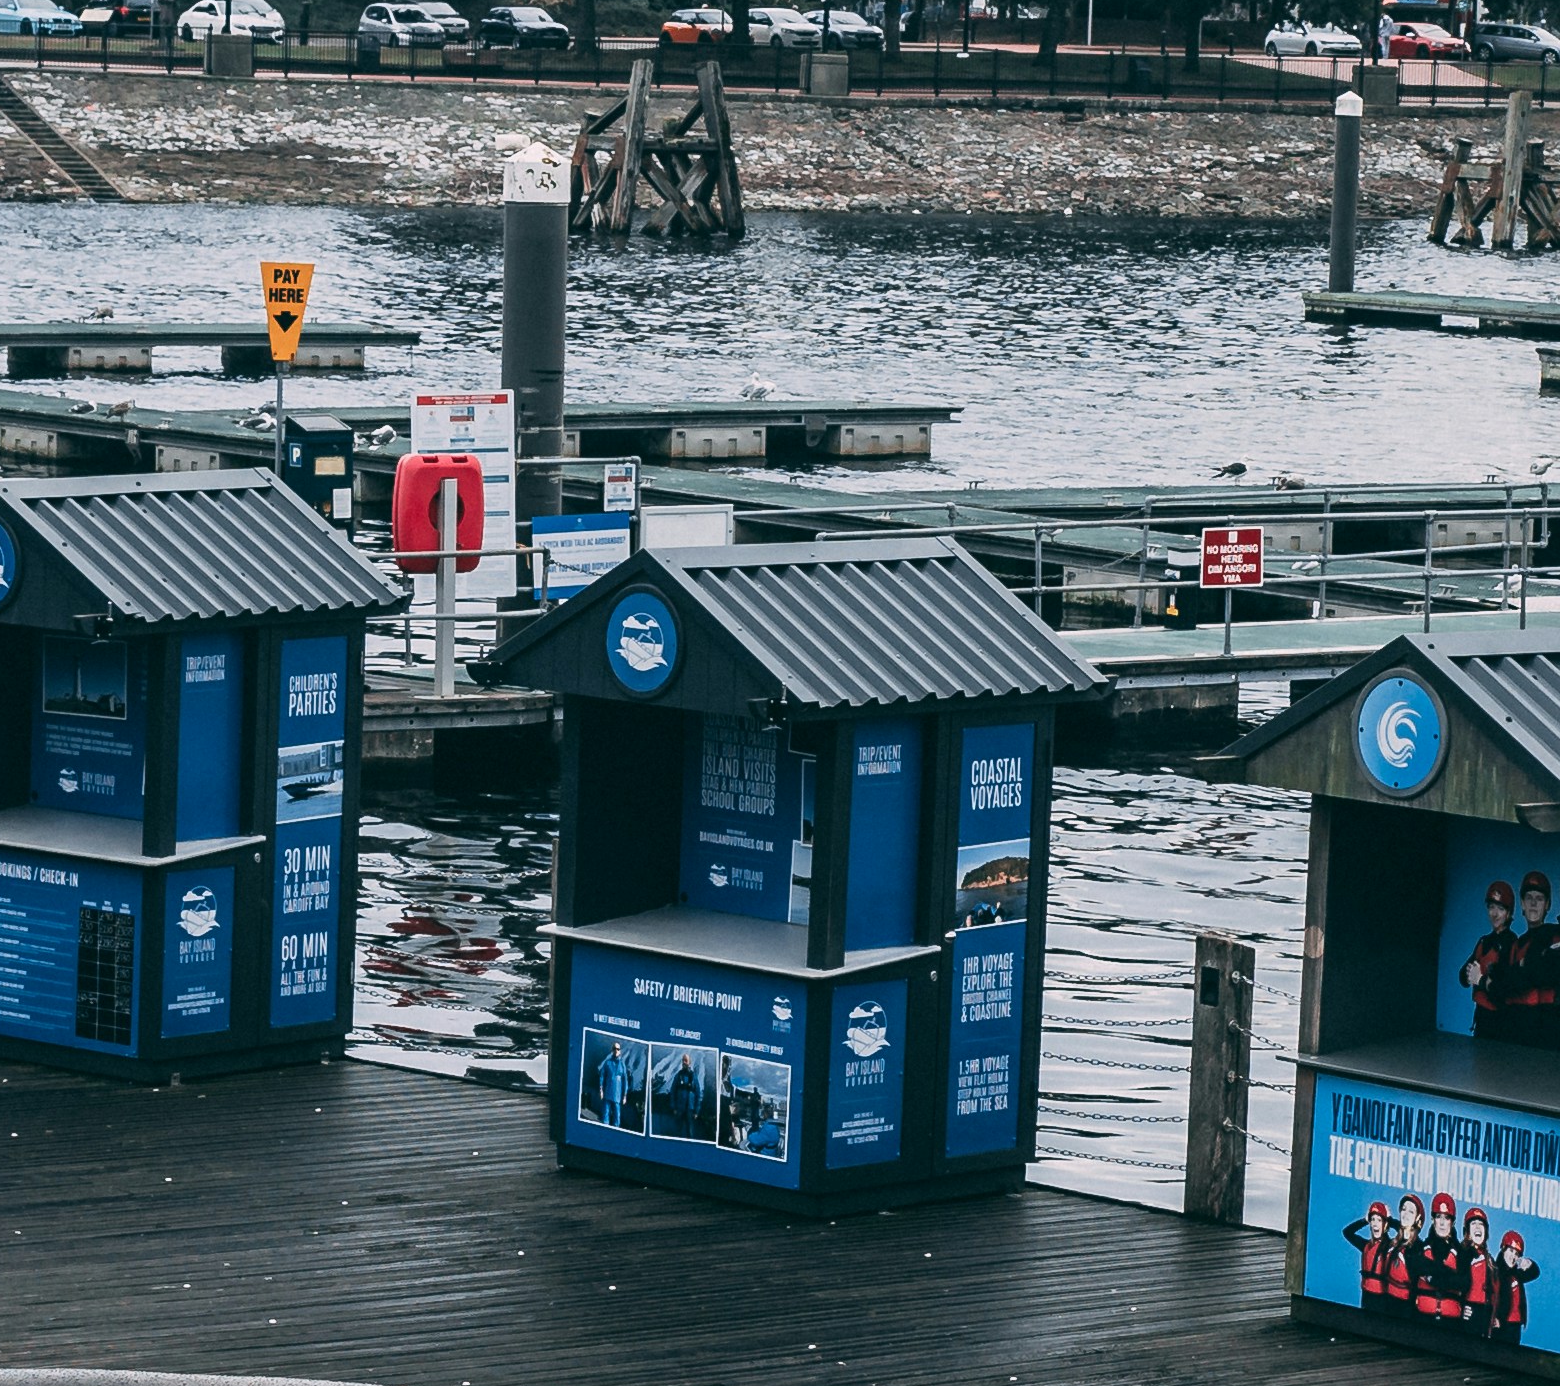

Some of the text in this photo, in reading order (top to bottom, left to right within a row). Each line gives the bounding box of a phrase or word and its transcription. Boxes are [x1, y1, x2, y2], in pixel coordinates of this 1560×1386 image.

[273, 268, 300, 284] PAY
[268, 287, 304, 303] HERE
[1206, 544, 1219, 554] NO
[289, 672, 338, 693] CHILDREN'S
[288, 689, 337, 718] PARTIES
[971, 757, 1023, 786] COASTAL
[701, 788, 775, 816] SCHOOL GROUPS
[970, 782, 1022, 811] VOYAGES
[284, 844, 331, 875] 30 MIN
[40, 867, 79, 888] CHECK-IN
[281, 931, 328, 961] 60 MIN
[633, 977, 665, 1000] SAFETY
[673, 984, 714, 1008] BRIEFING
[715, 991, 743, 1012] POINT
[1331, 1092, 1342, 1132] Y
[1342, 1094, 1414, 1148] GANOLFAN
[1414, 1109, 1436, 1152] AR
[1436, 1112, 1481, 1161] GYFER
[1482, 1122, 1532, 1170] ANTUR
[1329, 1134, 1354, 1177] THE
[1354, 1141, 1407, 1189] CENTRE
[1407, 1151, 1435, 1194] FOR
[1436, 1156, 1483, 1205] WATER
